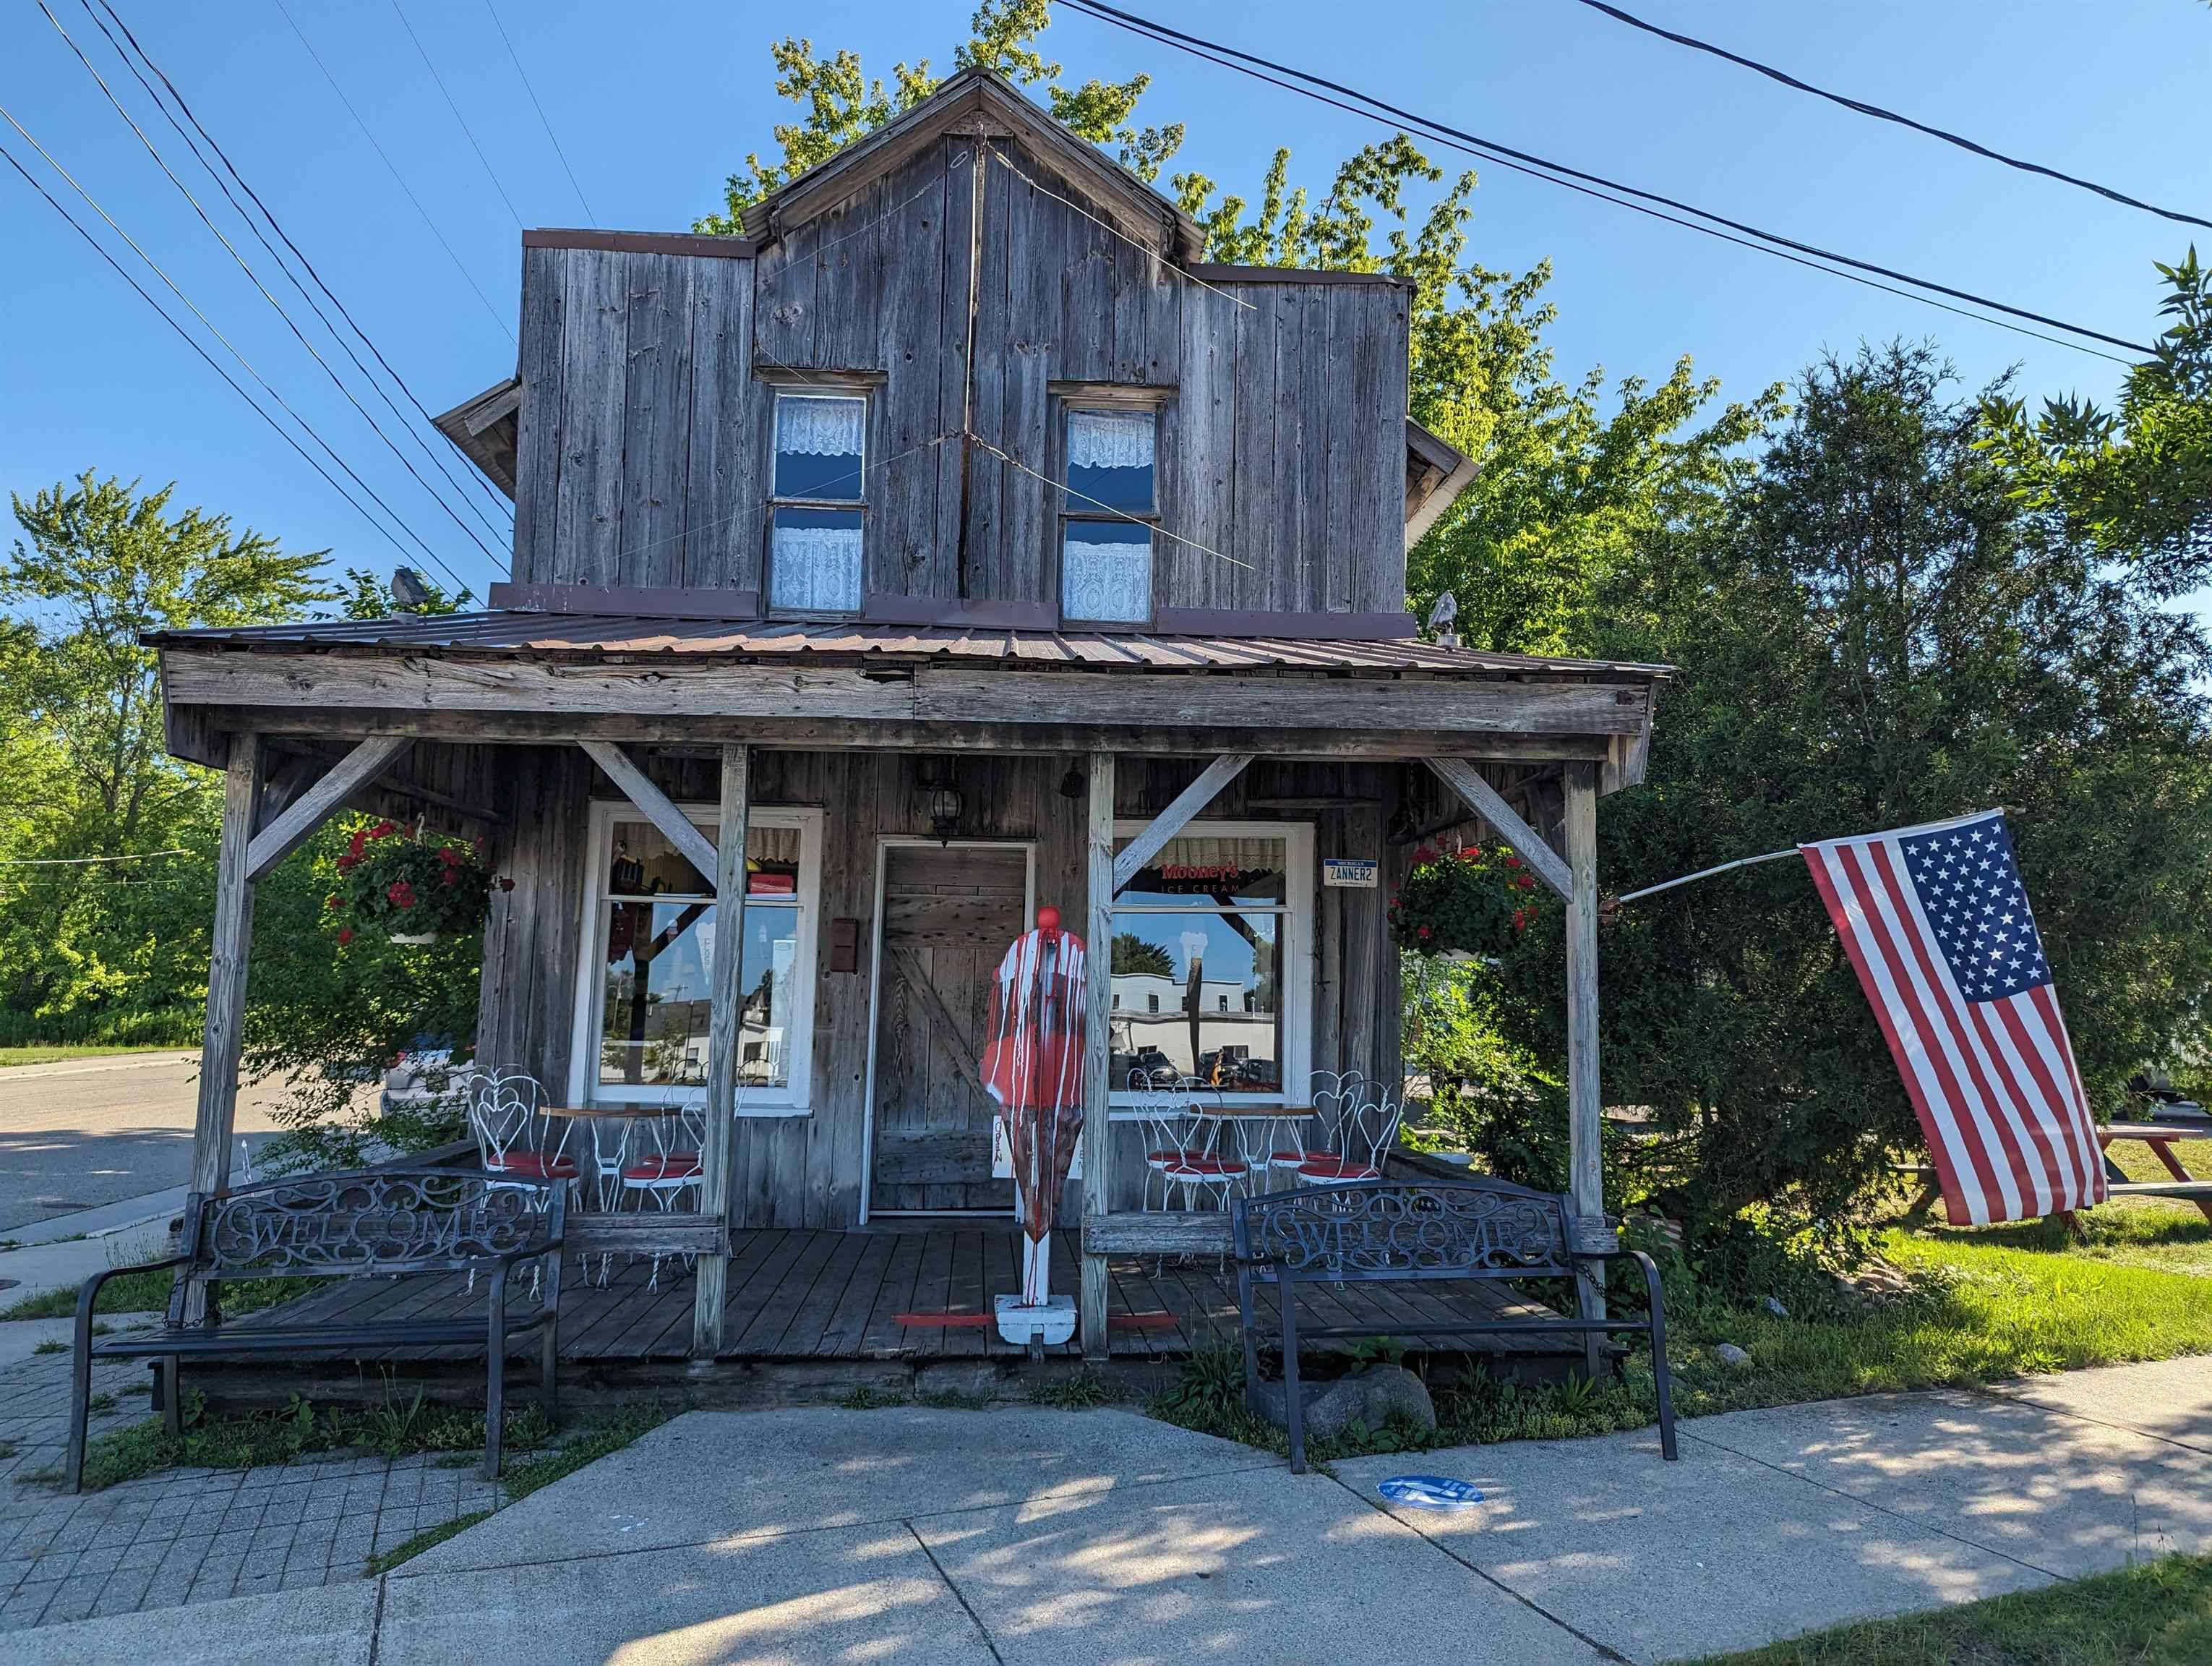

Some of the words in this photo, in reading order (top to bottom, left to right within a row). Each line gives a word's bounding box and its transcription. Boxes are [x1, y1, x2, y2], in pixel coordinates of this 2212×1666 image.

[1161, 860, 1238, 882] Mooney's
[1330, 866, 1372, 881] ZANNER2
[1161, 885, 1184, 894] ICE
[1193, 884, 1238, 893] CREAM
[249, 1208, 497, 1251] WELCOME
[1290, 1219, 1518, 1257] WELCOME
